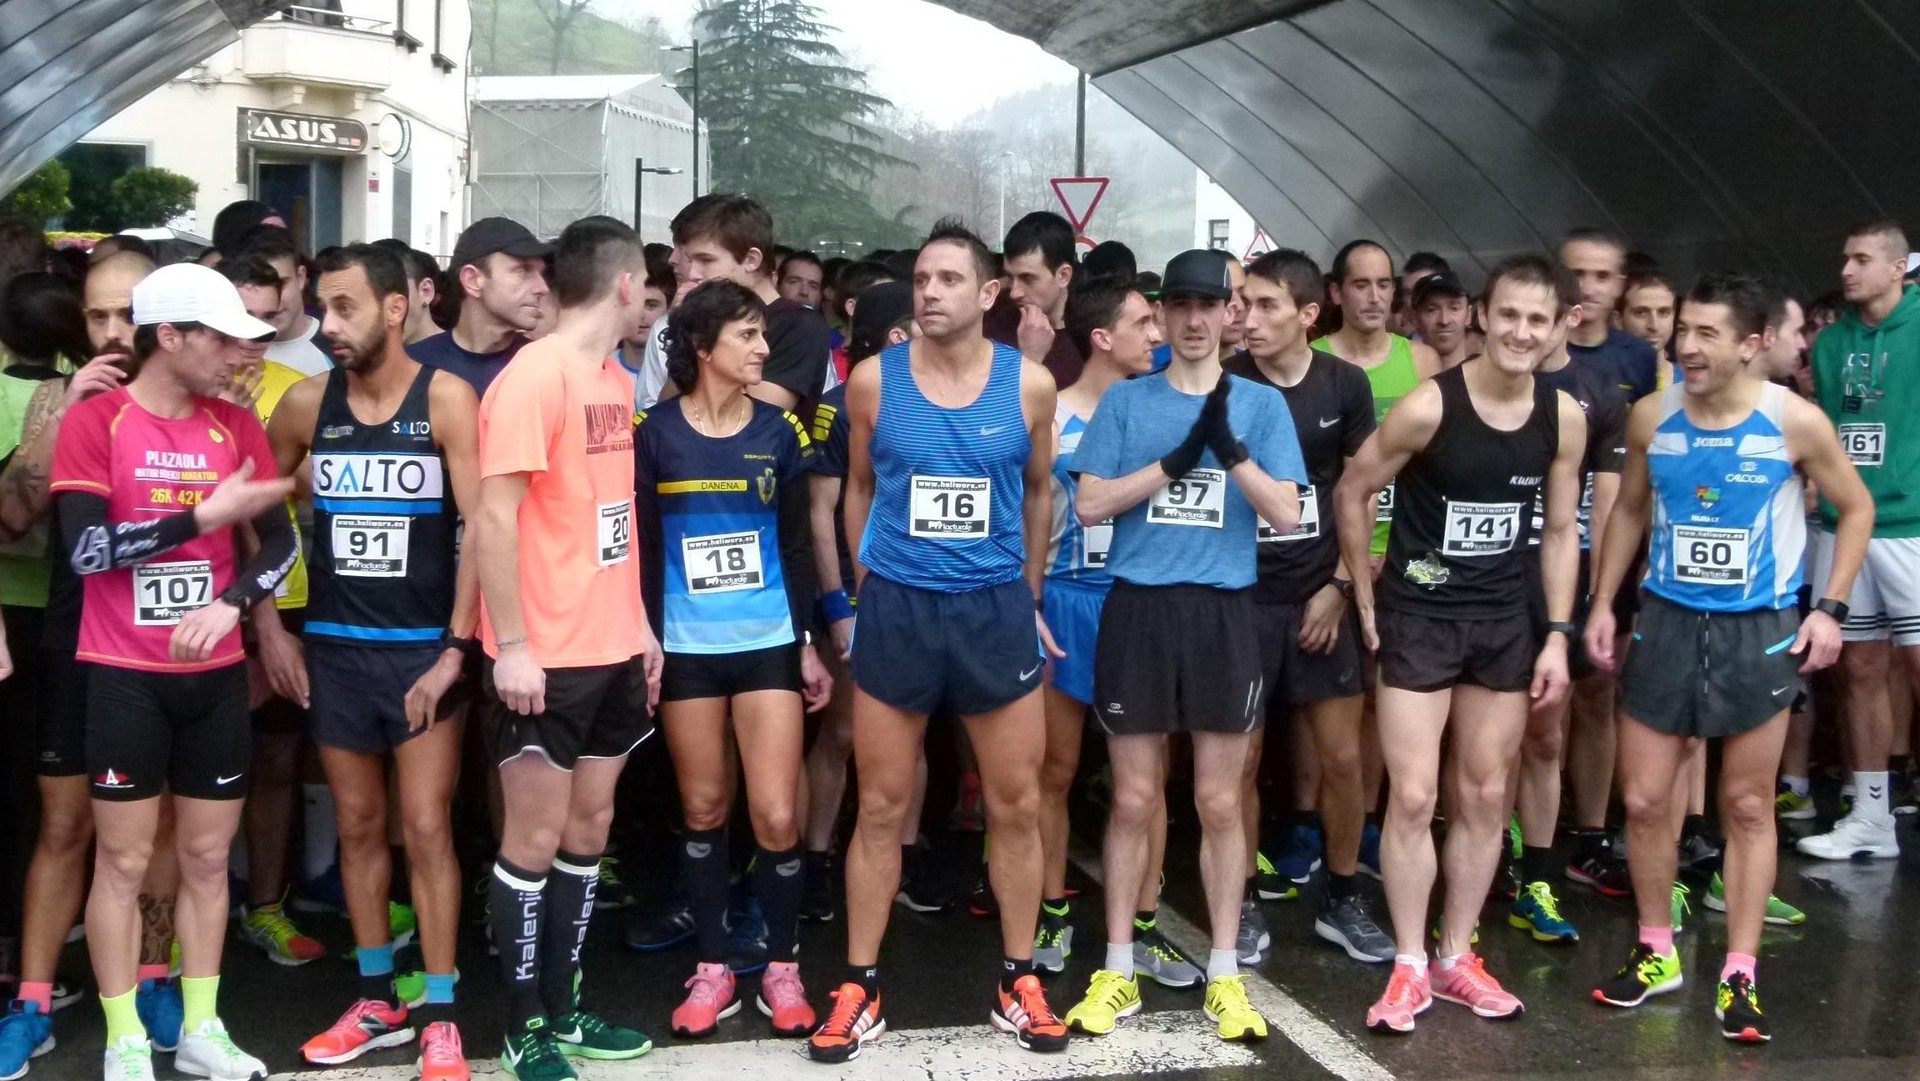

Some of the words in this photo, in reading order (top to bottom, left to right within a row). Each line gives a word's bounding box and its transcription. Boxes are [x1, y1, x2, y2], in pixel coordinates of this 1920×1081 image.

[254, 116, 337, 144] ASUS
[392, 421, 430, 434] SALTO
[1842, 433, 1880, 452] 161
[319, 459, 426, 495] SALTO
[701, 481, 740, 490] DANENA
[932, 492, 975, 518] 16
[1168, 480, 1210, 507] 97
[612, 515, 629, 544] 20
[1456, 516, 1512, 539] 141
[349, 531, 389, 556] 91
[1690, 541, 1732, 566] 60
[705, 547, 747, 573] 18
[144, 576, 210, 605] 107
